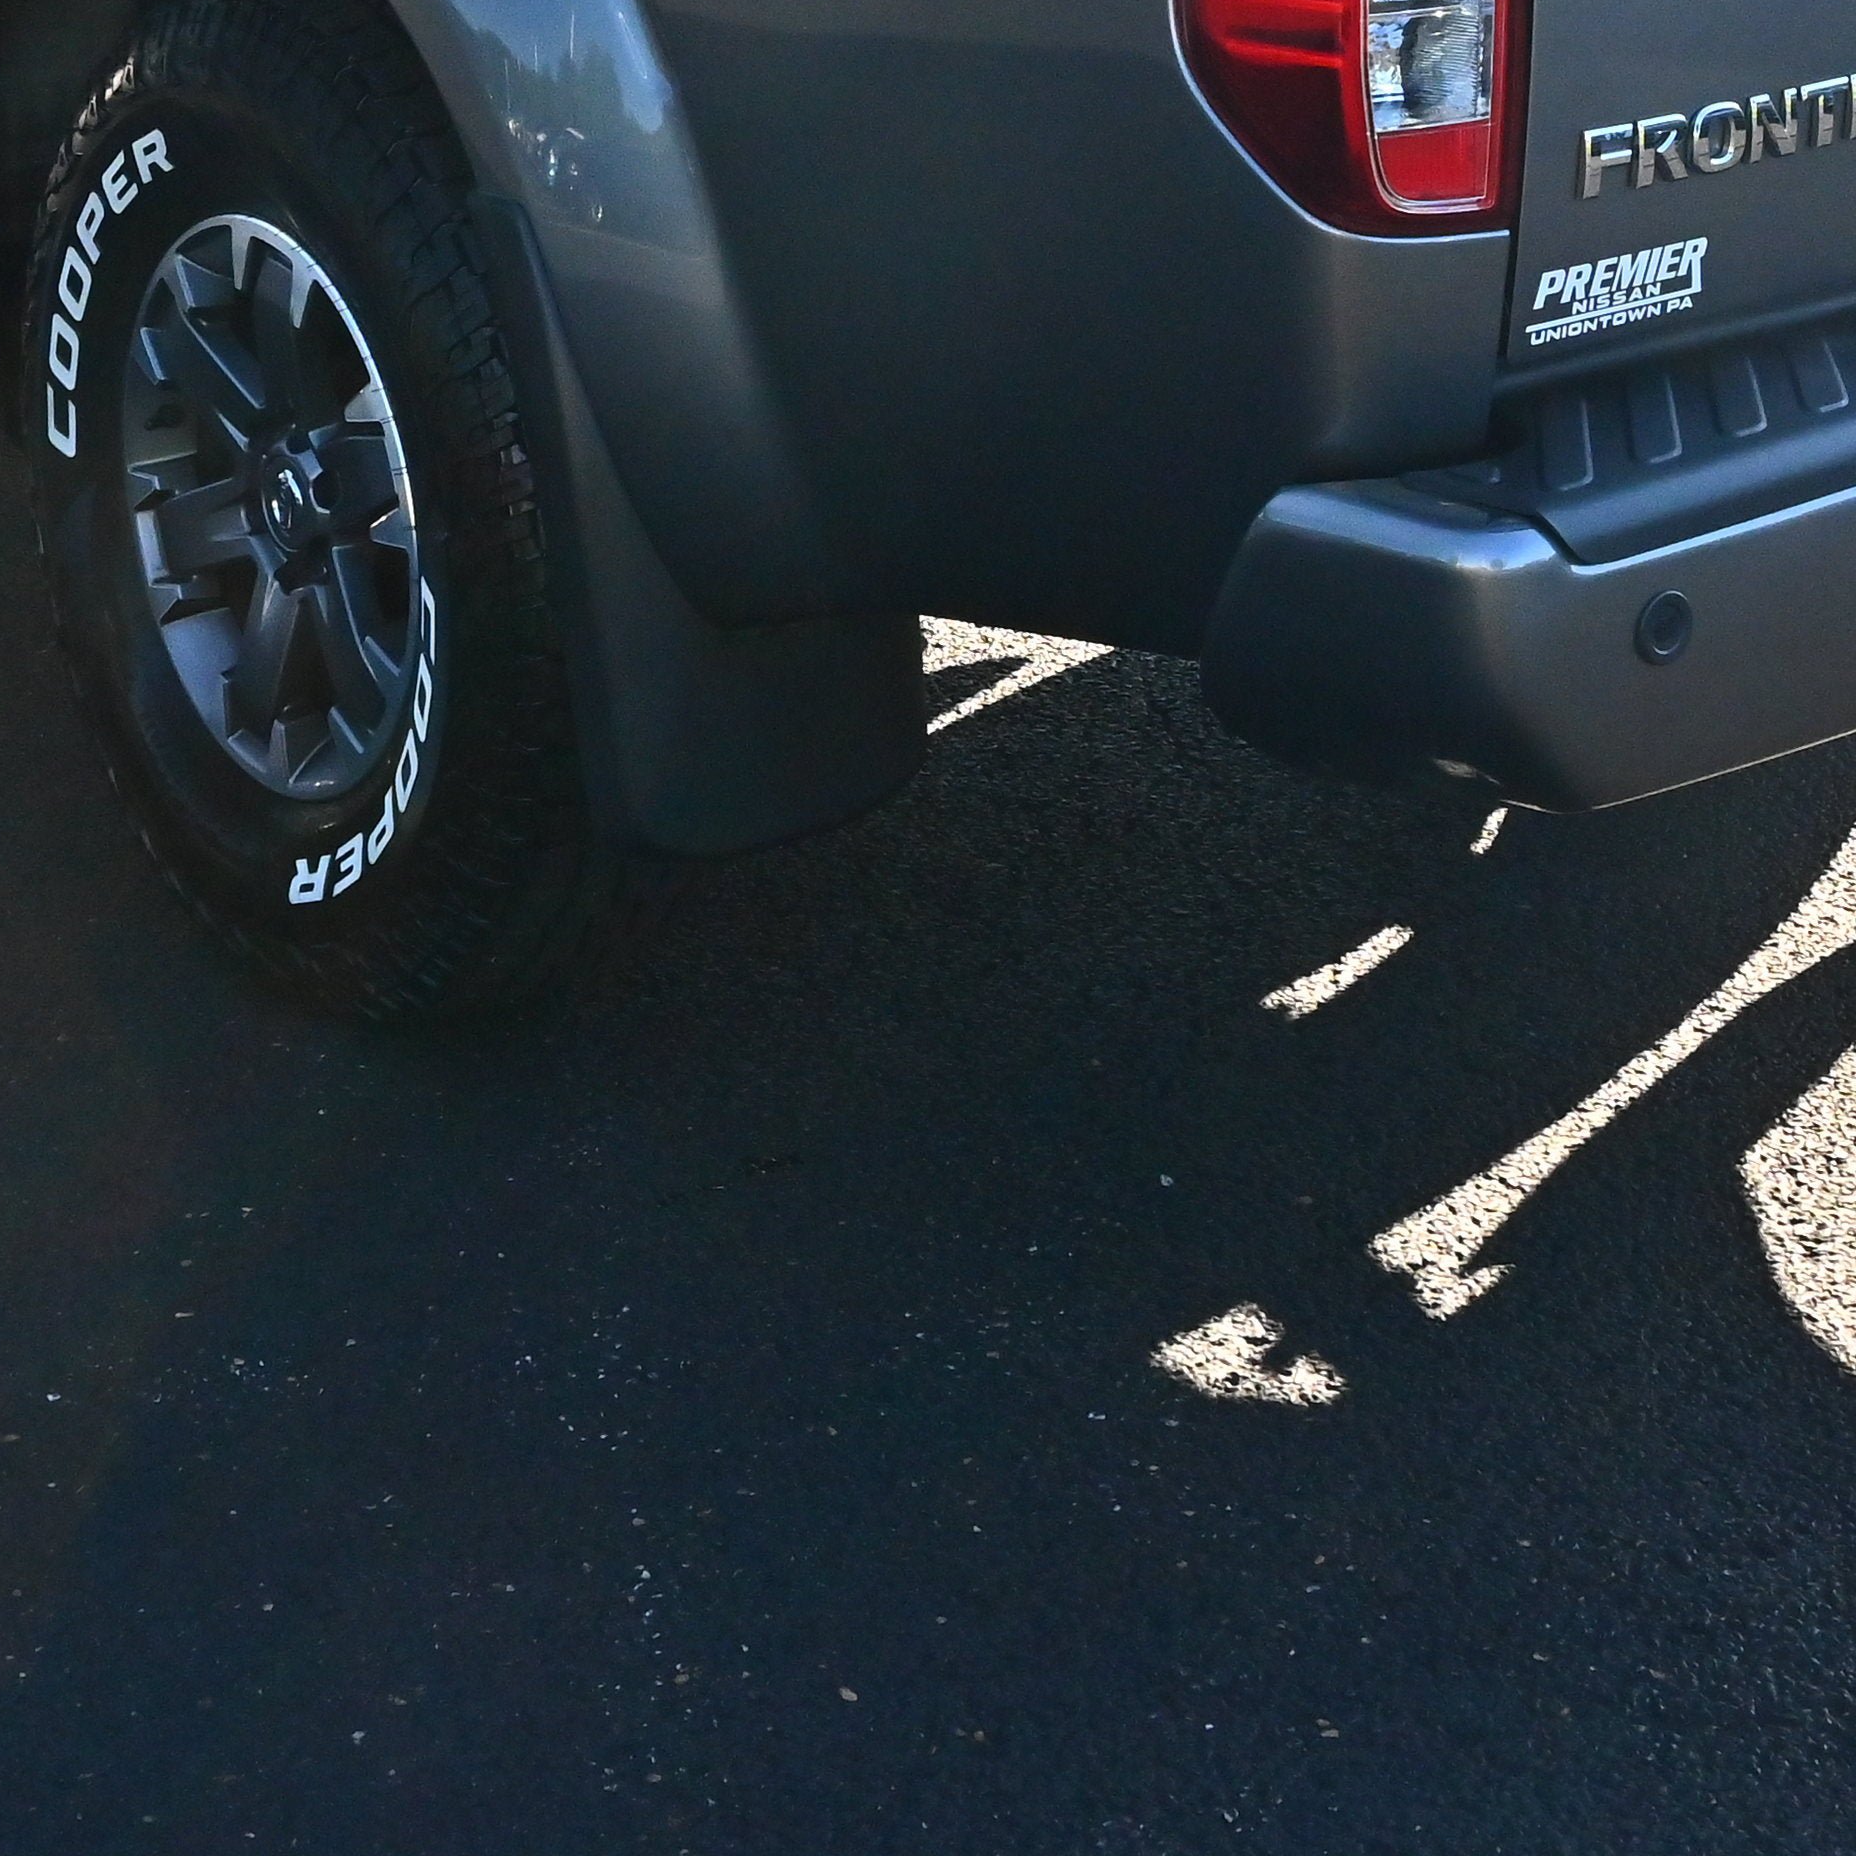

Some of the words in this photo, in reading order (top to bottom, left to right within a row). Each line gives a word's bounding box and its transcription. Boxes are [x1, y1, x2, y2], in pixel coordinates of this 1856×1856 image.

[46, 128, 174, 459] COOPER
[1532, 236, 1709, 311] PREMIER
[1571, 282, 1662, 315] NISSAN
[1530, 303, 1661, 346] UNIONTOWN
[1666, 296, 1694, 314] PA
[288, 575, 436, 905] COOPER
